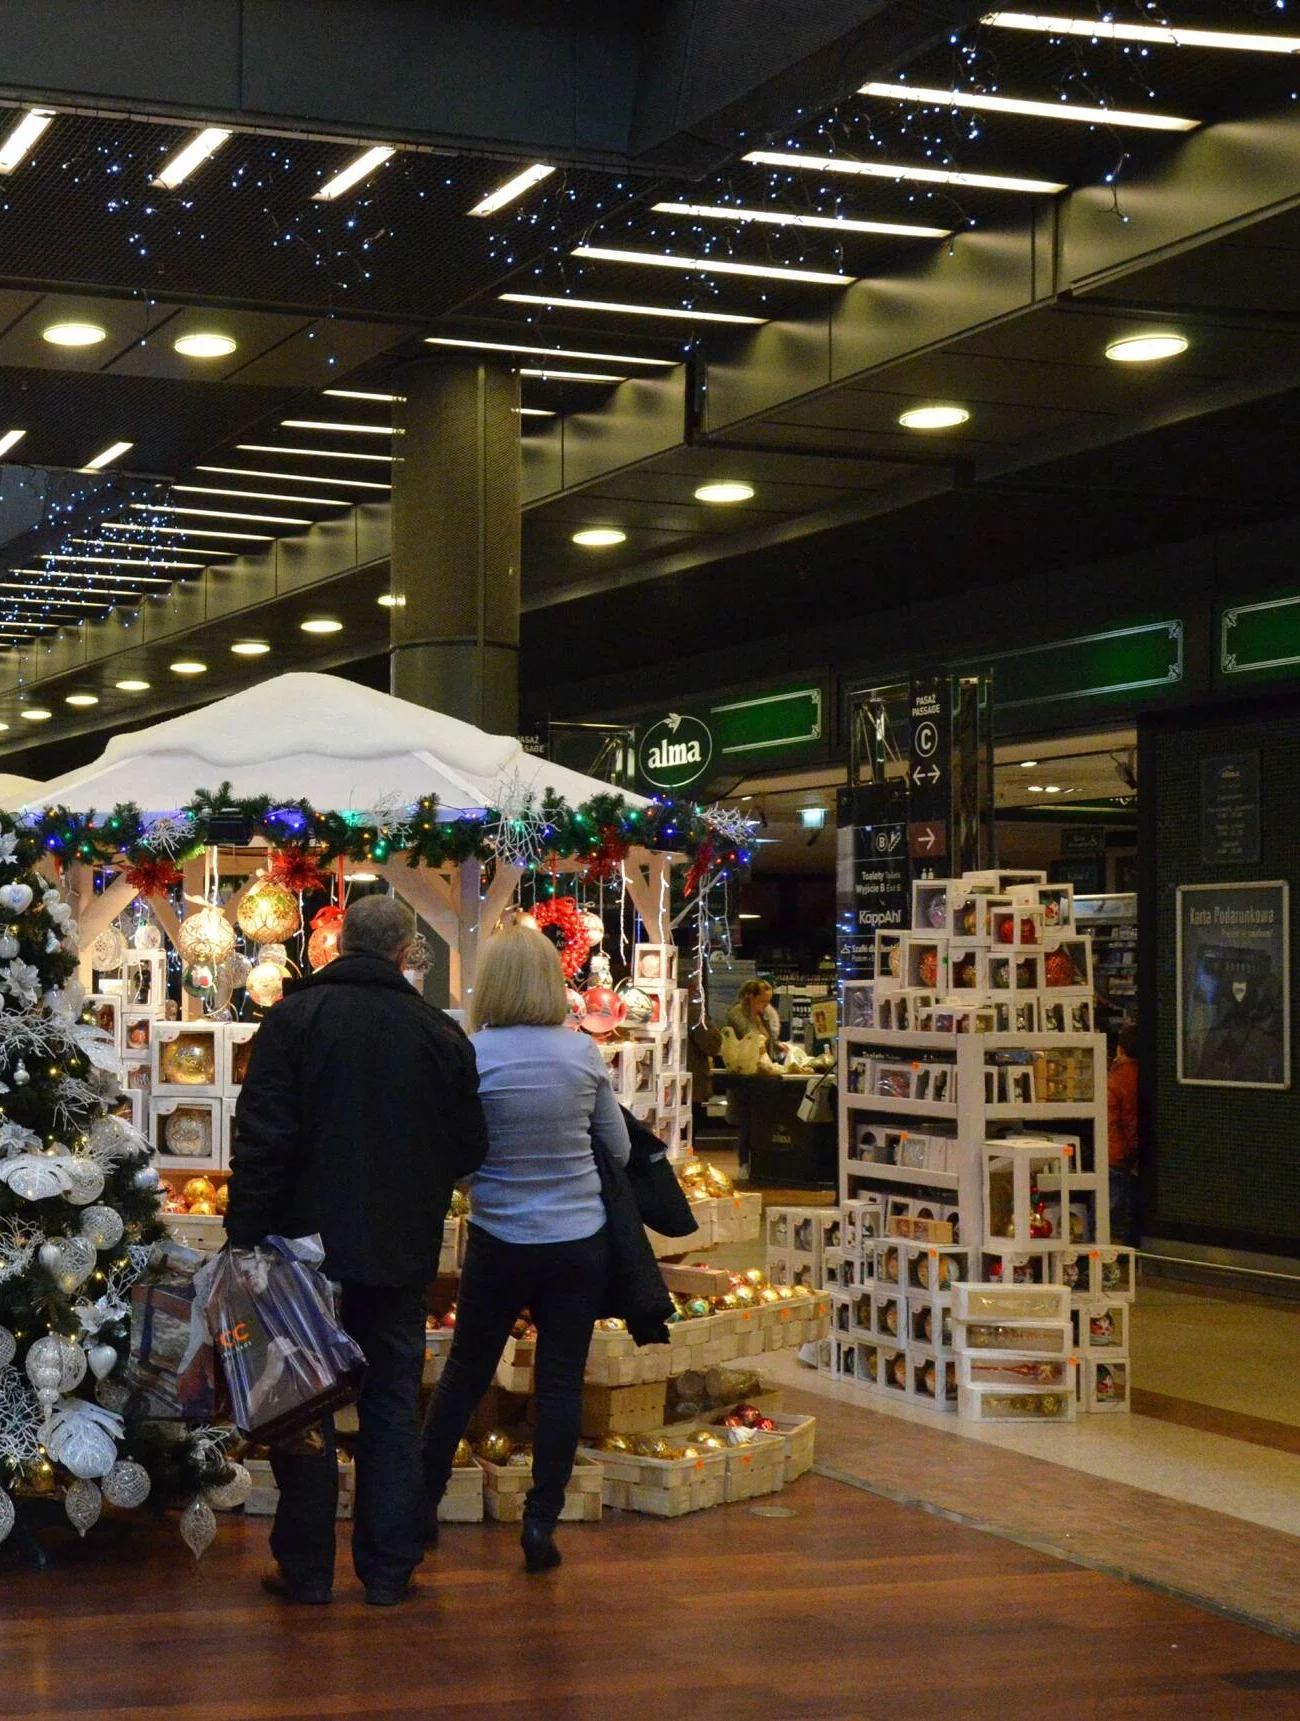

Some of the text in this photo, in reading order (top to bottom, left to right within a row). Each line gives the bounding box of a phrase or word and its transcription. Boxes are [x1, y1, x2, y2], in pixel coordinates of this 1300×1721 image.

[912, 704, 940, 717] PASSAGE
[921, 729, 931, 750] C
[648, 739, 701, 769] alma
[862, 871, 884, 882] Toalety
[859, 910, 902, 925] KappAhl
[1190, 905, 1275, 925] Karta Podarunkowa
